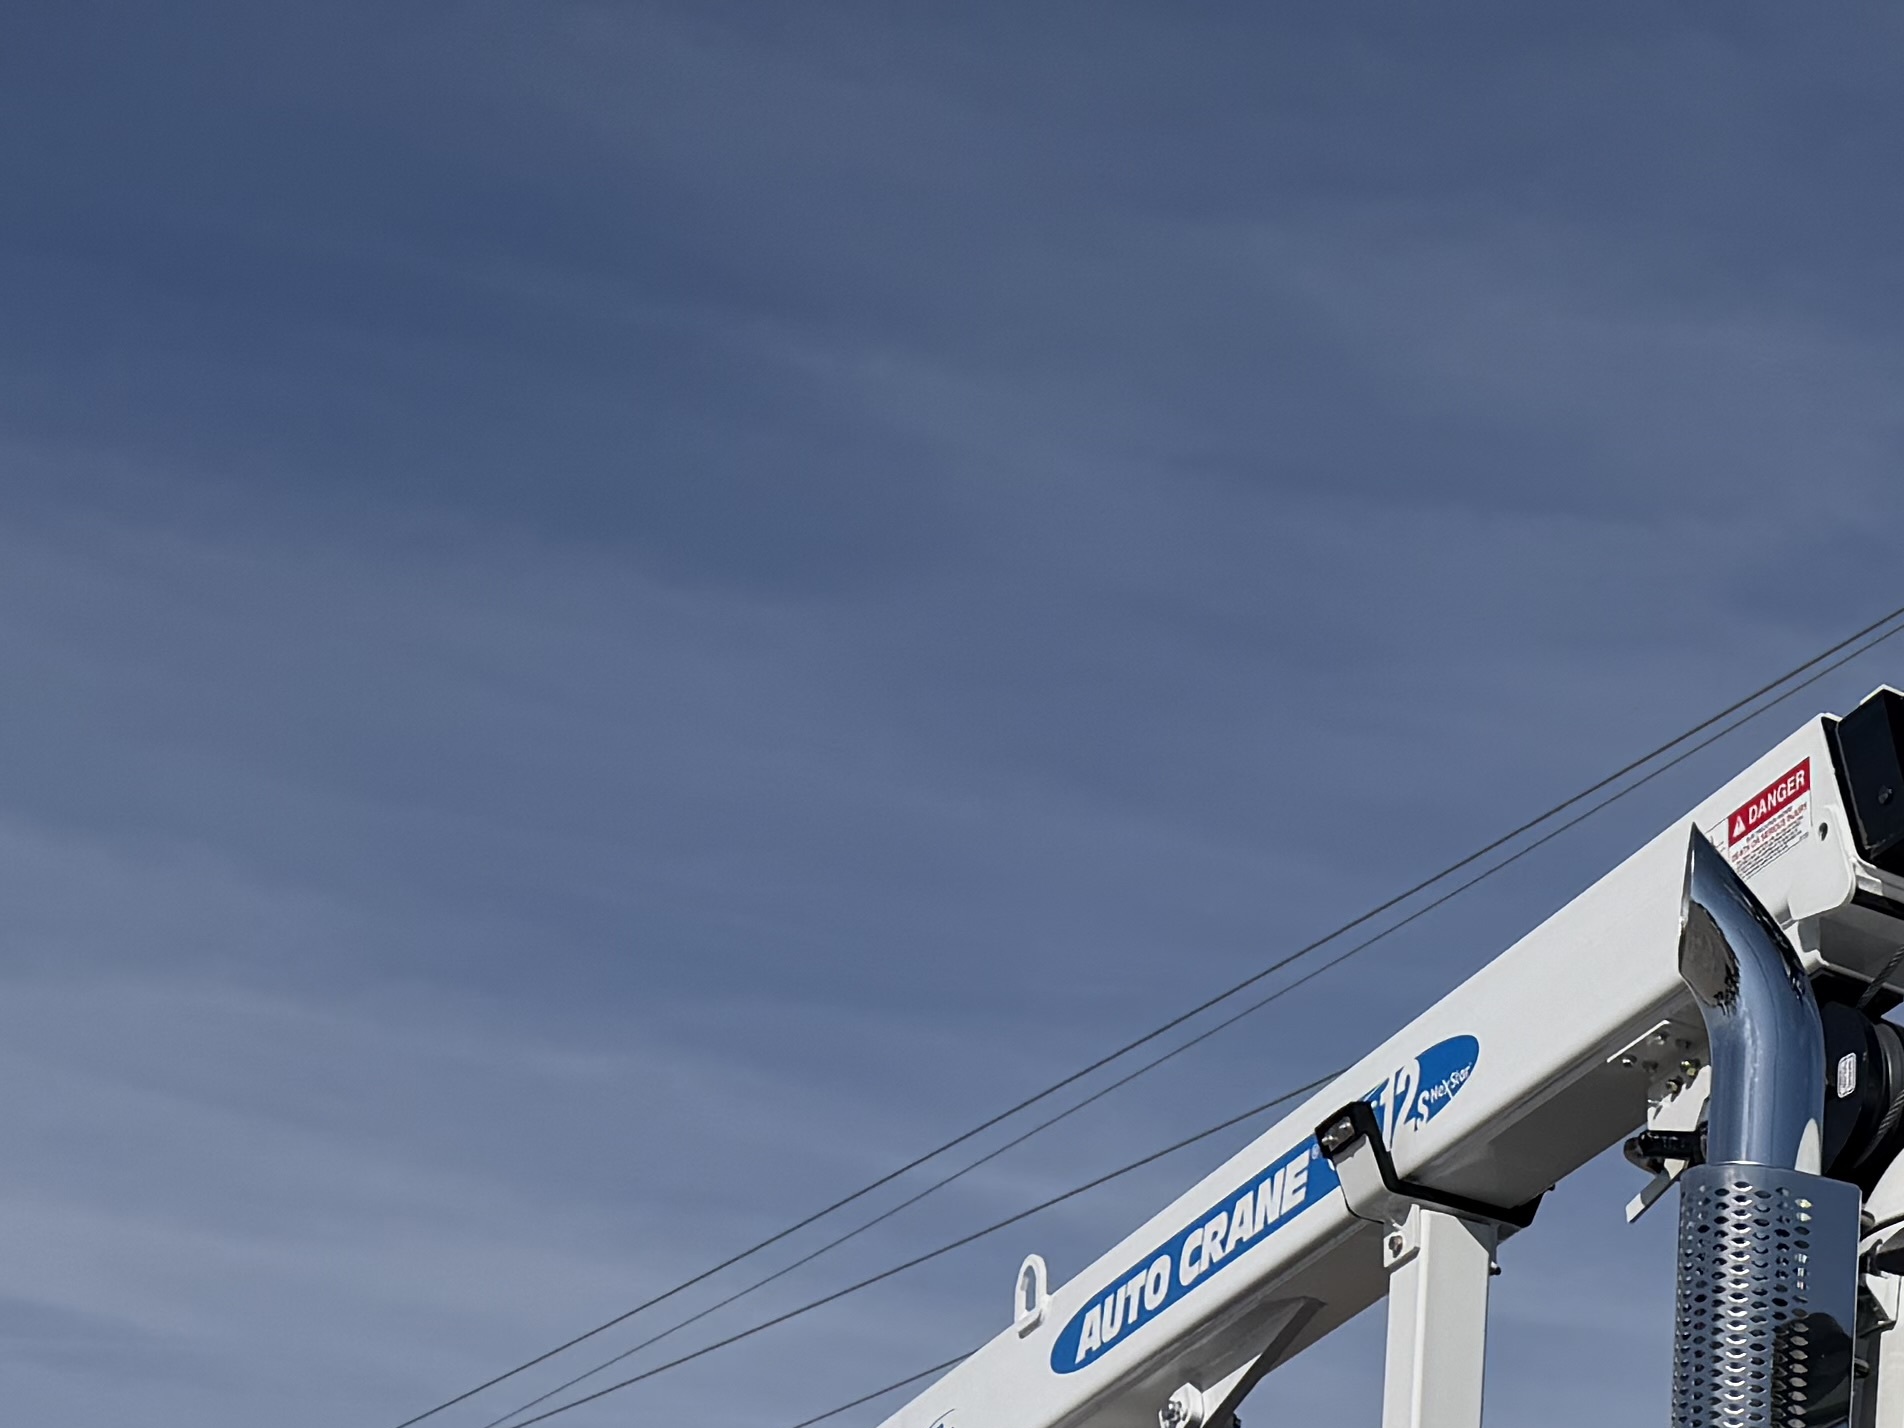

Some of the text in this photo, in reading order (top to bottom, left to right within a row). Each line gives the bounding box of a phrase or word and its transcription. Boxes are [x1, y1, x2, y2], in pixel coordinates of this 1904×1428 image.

[1748, 769, 1805, 825] DANGER
[1075, 1149, 1311, 1365] AUTO CRANE
